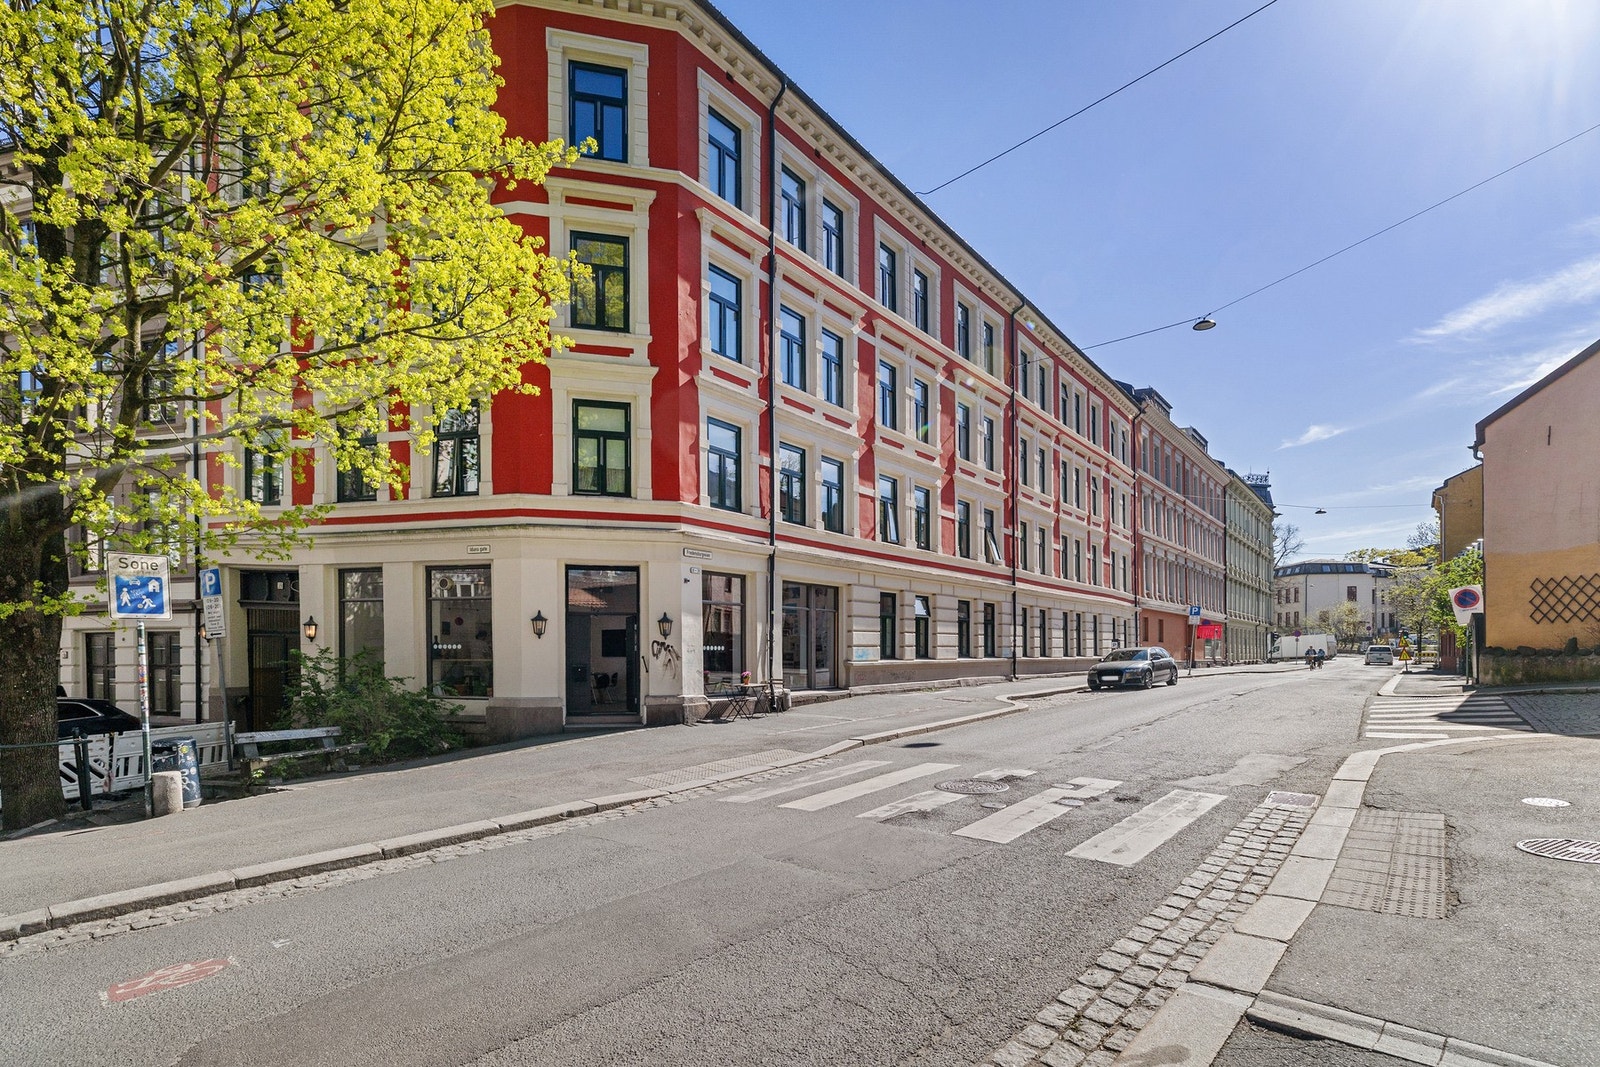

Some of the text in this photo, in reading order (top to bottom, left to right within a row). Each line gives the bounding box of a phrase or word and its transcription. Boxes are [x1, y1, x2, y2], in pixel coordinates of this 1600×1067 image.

[119, 557, 159, 571] Sone
[205, 572, 216, 593] P
[1191, 607, 1199, 615] P
